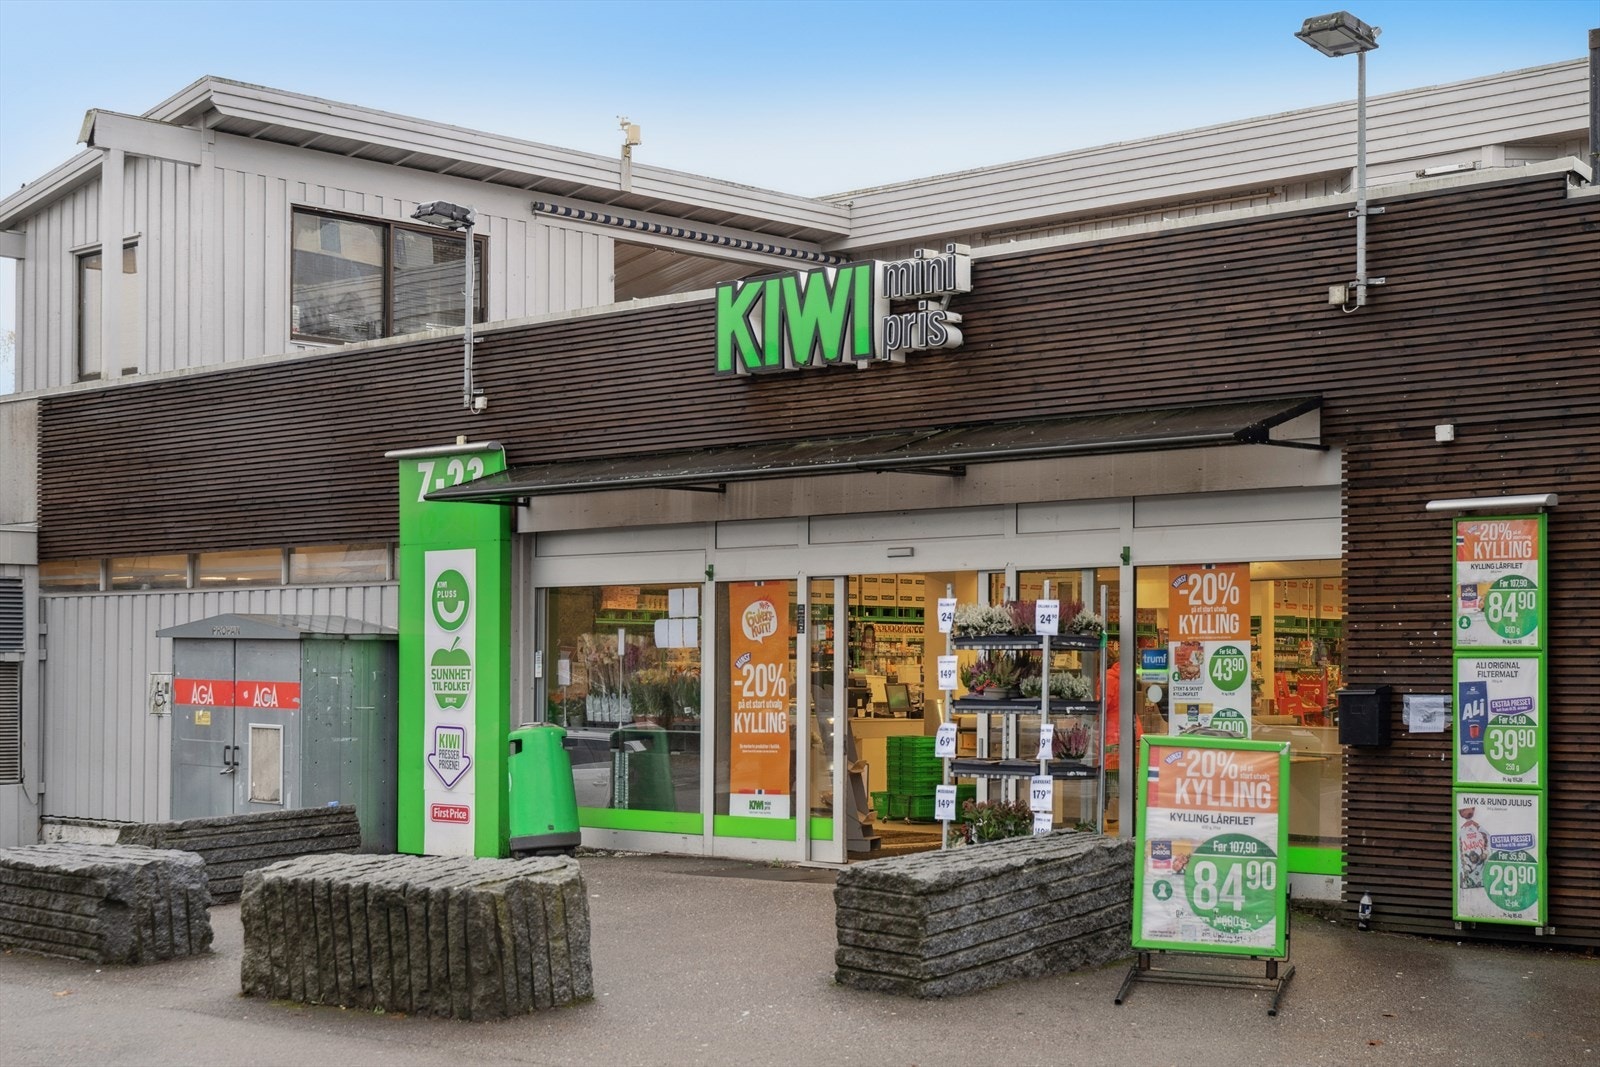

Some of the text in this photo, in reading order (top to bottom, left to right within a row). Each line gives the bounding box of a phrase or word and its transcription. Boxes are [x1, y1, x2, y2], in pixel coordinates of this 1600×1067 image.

[882, 243, 957, 299] mini
[715, 261, 875, 376] KIWI
[882, 300, 950, 363] pris
[1475, 523, 1512, 541] -20%
[1474, 541, 1532, 559] KYLLING
[1496, 562, 1523, 570] LÅRFILET
[1179, 572, 1239, 606] -20%
[212, 626, 241, 636] PROPAN
[1179, 614, 1240, 635] KYLLING
[1142, 653, 1166, 664] trumf
[1488, 661, 1520, 670] ORIGINAL
[431, 668, 472, 680] SUNNHET
[734, 662, 787, 698] -20%
[1477, 670, 1519, 678] FILTERMALT
[191, 682, 214, 705] AGA
[432, 681, 470, 692] TIL FOLKET
[253, 684, 279, 708] AGA
[1510, 698, 1532, 707] PRESSET
[734, 712, 787, 734] KYLLING
[1509, 716, 1526, 726] 54,90
[439, 734, 460, 749] KIWI
[438, 749, 460, 760] PRESSER
[438, 760, 460, 770] PRISENE!
[1176, 750, 1238, 780] -20%
[1175, 778, 1270, 809] KYLLING
[748, 800, 764, 810] KIWI
[1463, 797, 1479, 805] MYK
[1487, 798, 1508, 806] RUND
[1508, 798, 1532, 807] JULIUS
[434, 808, 467, 820] First Price
[1169, 812, 1256, 826] KYLLING LÅRFILET
[1510, 834, 1532, 842] PRESSET
[1213, 840, 1257, 854] Før 107,90
